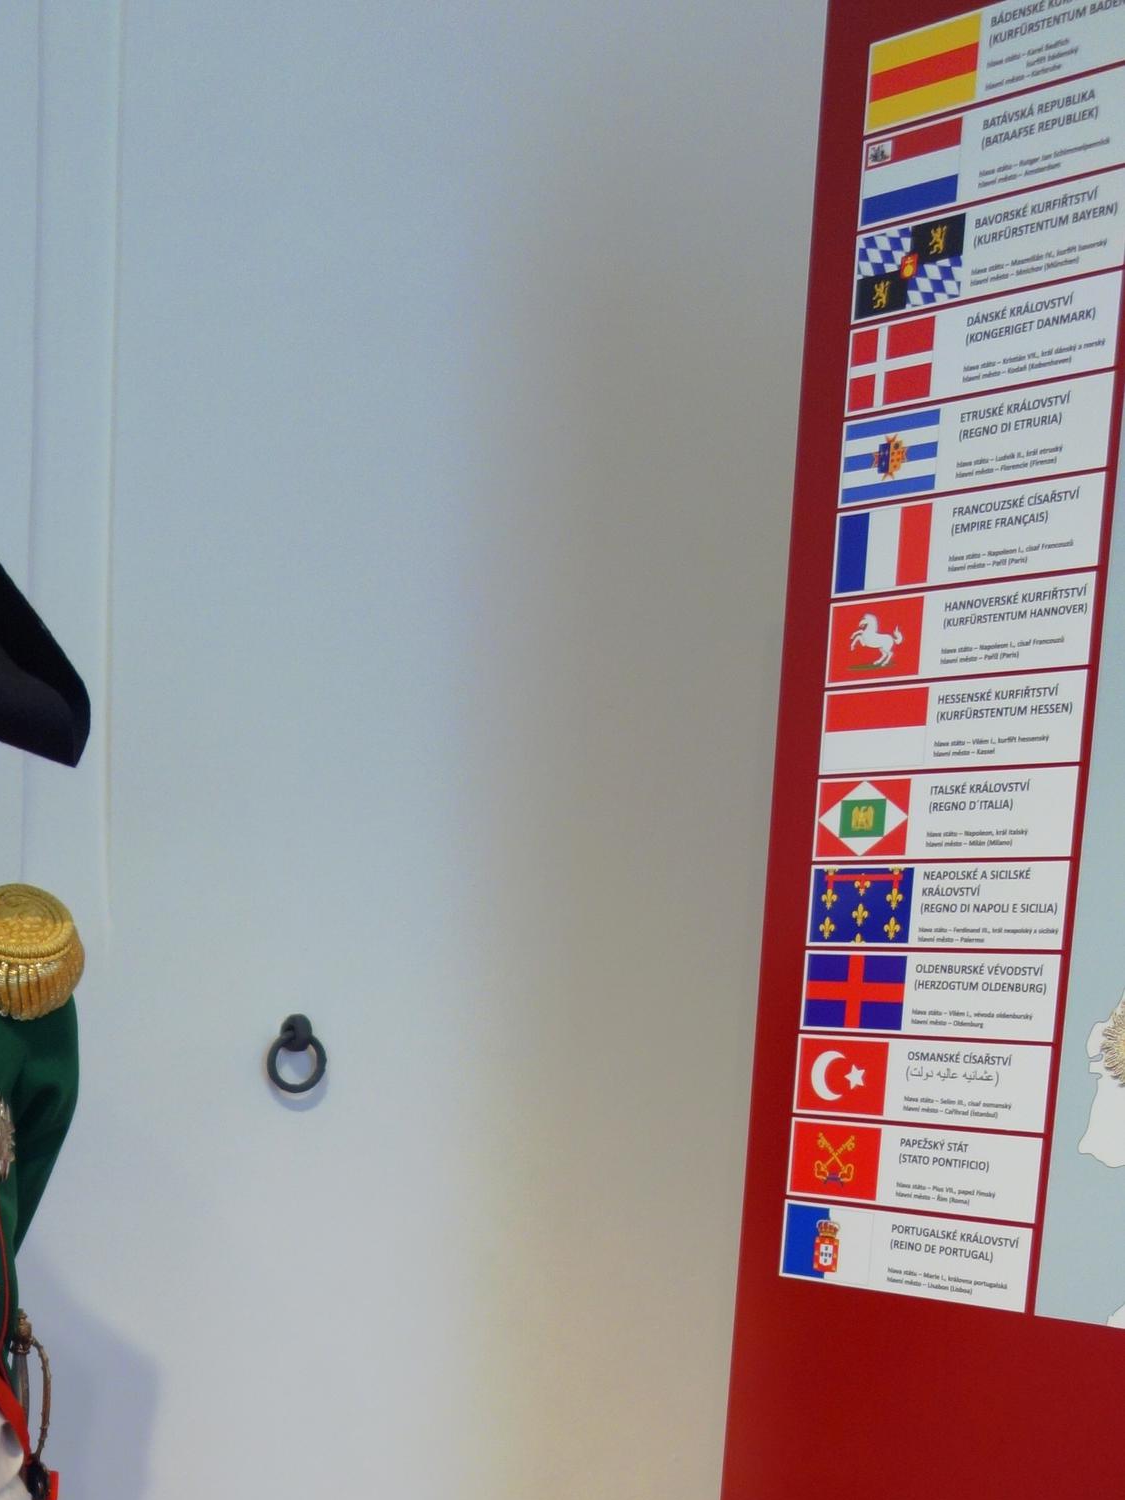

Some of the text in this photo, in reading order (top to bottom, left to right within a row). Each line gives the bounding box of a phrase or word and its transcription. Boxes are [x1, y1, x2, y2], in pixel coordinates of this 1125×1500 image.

[991, 1, 1046, 27] BÁDENSKÉ
[989, 6, 1086, 48] (KURFÜRSTENTUM
[983, 89, 1095, 130] BATÁVSKÁ REPUBLIKA
[982, 106, 1099, 150] (BATAAFSE REPUBLIEK)
[975, 186, 1099, 229] BAVORSKÉ KURFIŘTSTVÍ
[973, 202, 1118, 248] (KURFÜRSTENTUM BAYERN)
[967, 292, 1074, 327] DÁNSKÉ KRÁLOVSTVÍ
[966, 307, 1096, 346] (KONGERIGET DANMARK)
[961, 391, 1071, 423] ETRUSKÉ KRÁLOVSTVÍ
[959, 412, 1062, 442] (REGNO DI ETRURIA)
[953, 486, 1080, 518] FRANCOUZSKÉ CÍSAŘSTVÍ
[951, 511, 1049, 536] (EMPIRE FRANÇAIS)
[945, 584, 1088, 612] HANNOVERSKÉ KURFIŘTSTVÍ
[943, 603, 1088, 629] (KURFÜRSTENTUM HANNOVER)
[938, 684, 1059, 705] HESSENSKÉ KURFIŘTSTVÍ
[937, 702, 1073, 723] (KURFÜRSTENTUM HESSEN)
[931, 779, 1031, 795] ITALSKÉ KRÁLOVSTVÍ
[929, 801, 966, 814] (REGNO
[923, 868, 1031, 880] NEAPOLSKÉ A SICILSKÉ
[922, 884, 981, 896] KRÁLOVSTVÍ
[921, 903, 1058, 915] (REGNO DI NAPOLI E SICILIA)
[916, 963, 1044, 976] OLDENBURSKÉ VÉVODSTVÍ
[915, 980, 1047, 995] (HERZOGTUM OLDENBURG)
[908, 1051, 1012, 1066] OSMANSKÉ CÍSAŘSTVÍ
[900, 1138, 968, 1153] PAPEŽSKÝ STÁT
[899, 1153, 989, 1173] (STATO PONTIFICIO)
[892, 1224, 1019, 1248] PORTUGALSKÉ KRÁLOVSTVÍ
[890, 1239, 993, 1263] (REINO DE PORTUGAL)
